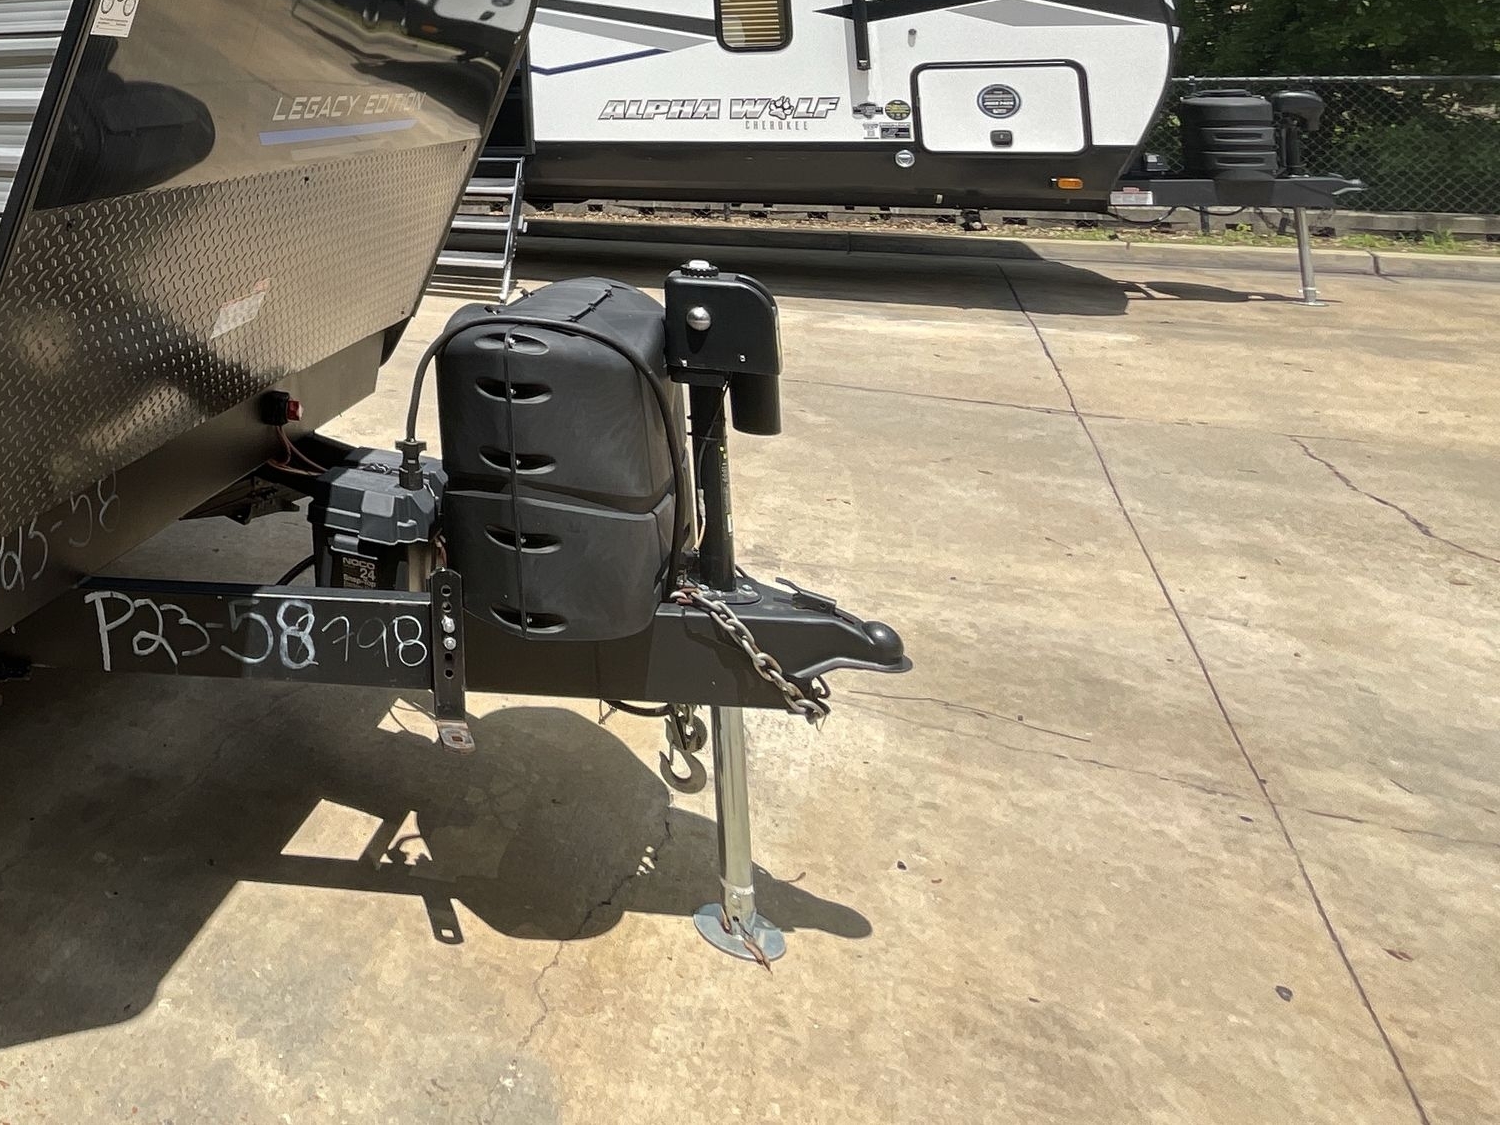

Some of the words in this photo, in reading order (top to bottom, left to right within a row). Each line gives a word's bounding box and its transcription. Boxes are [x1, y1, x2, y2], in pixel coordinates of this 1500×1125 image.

[272, 95, 362, 121] LEGACY
[363, 91, 427, 115] EDITION
[598, 98, 721, 120] ALPHA
[745, 120, 808, 130] CHEROKEE
[342, 557, 376, 570] NOCO
[359, 567, 376, 581] 24
